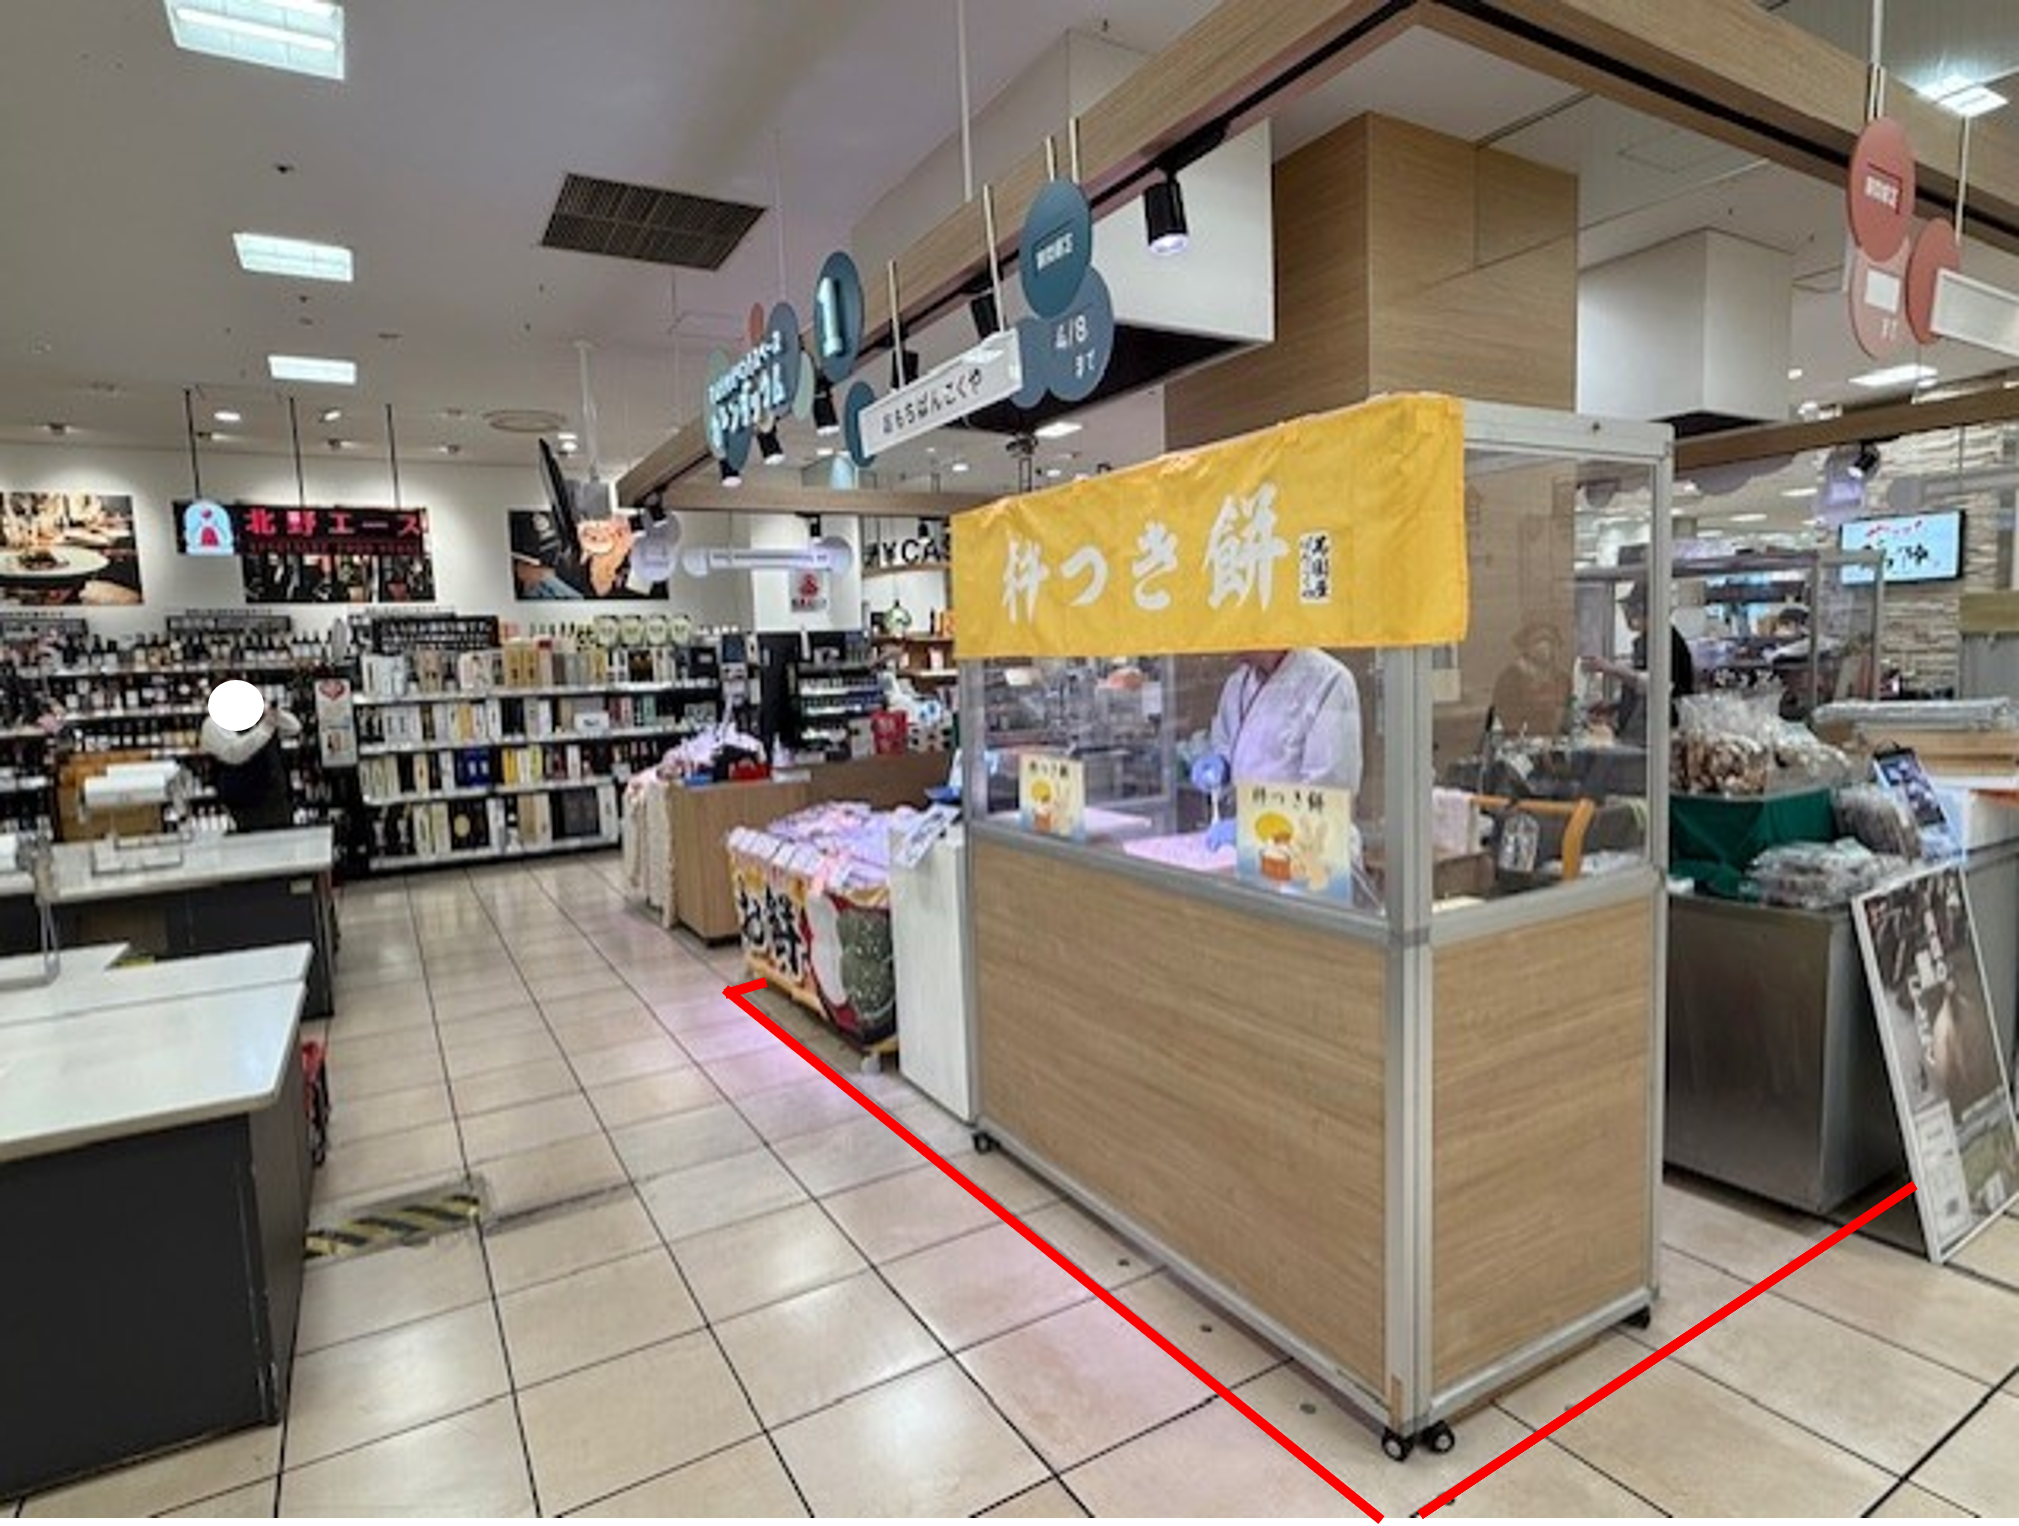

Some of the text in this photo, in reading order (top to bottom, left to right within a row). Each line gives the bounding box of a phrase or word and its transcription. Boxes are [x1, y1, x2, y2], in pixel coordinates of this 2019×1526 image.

[1055, 314, 1089, 349] 4/8
[244, 507, 421, 537] 北野エース
[1002, 482, 1289, 624] 杵つき餅
